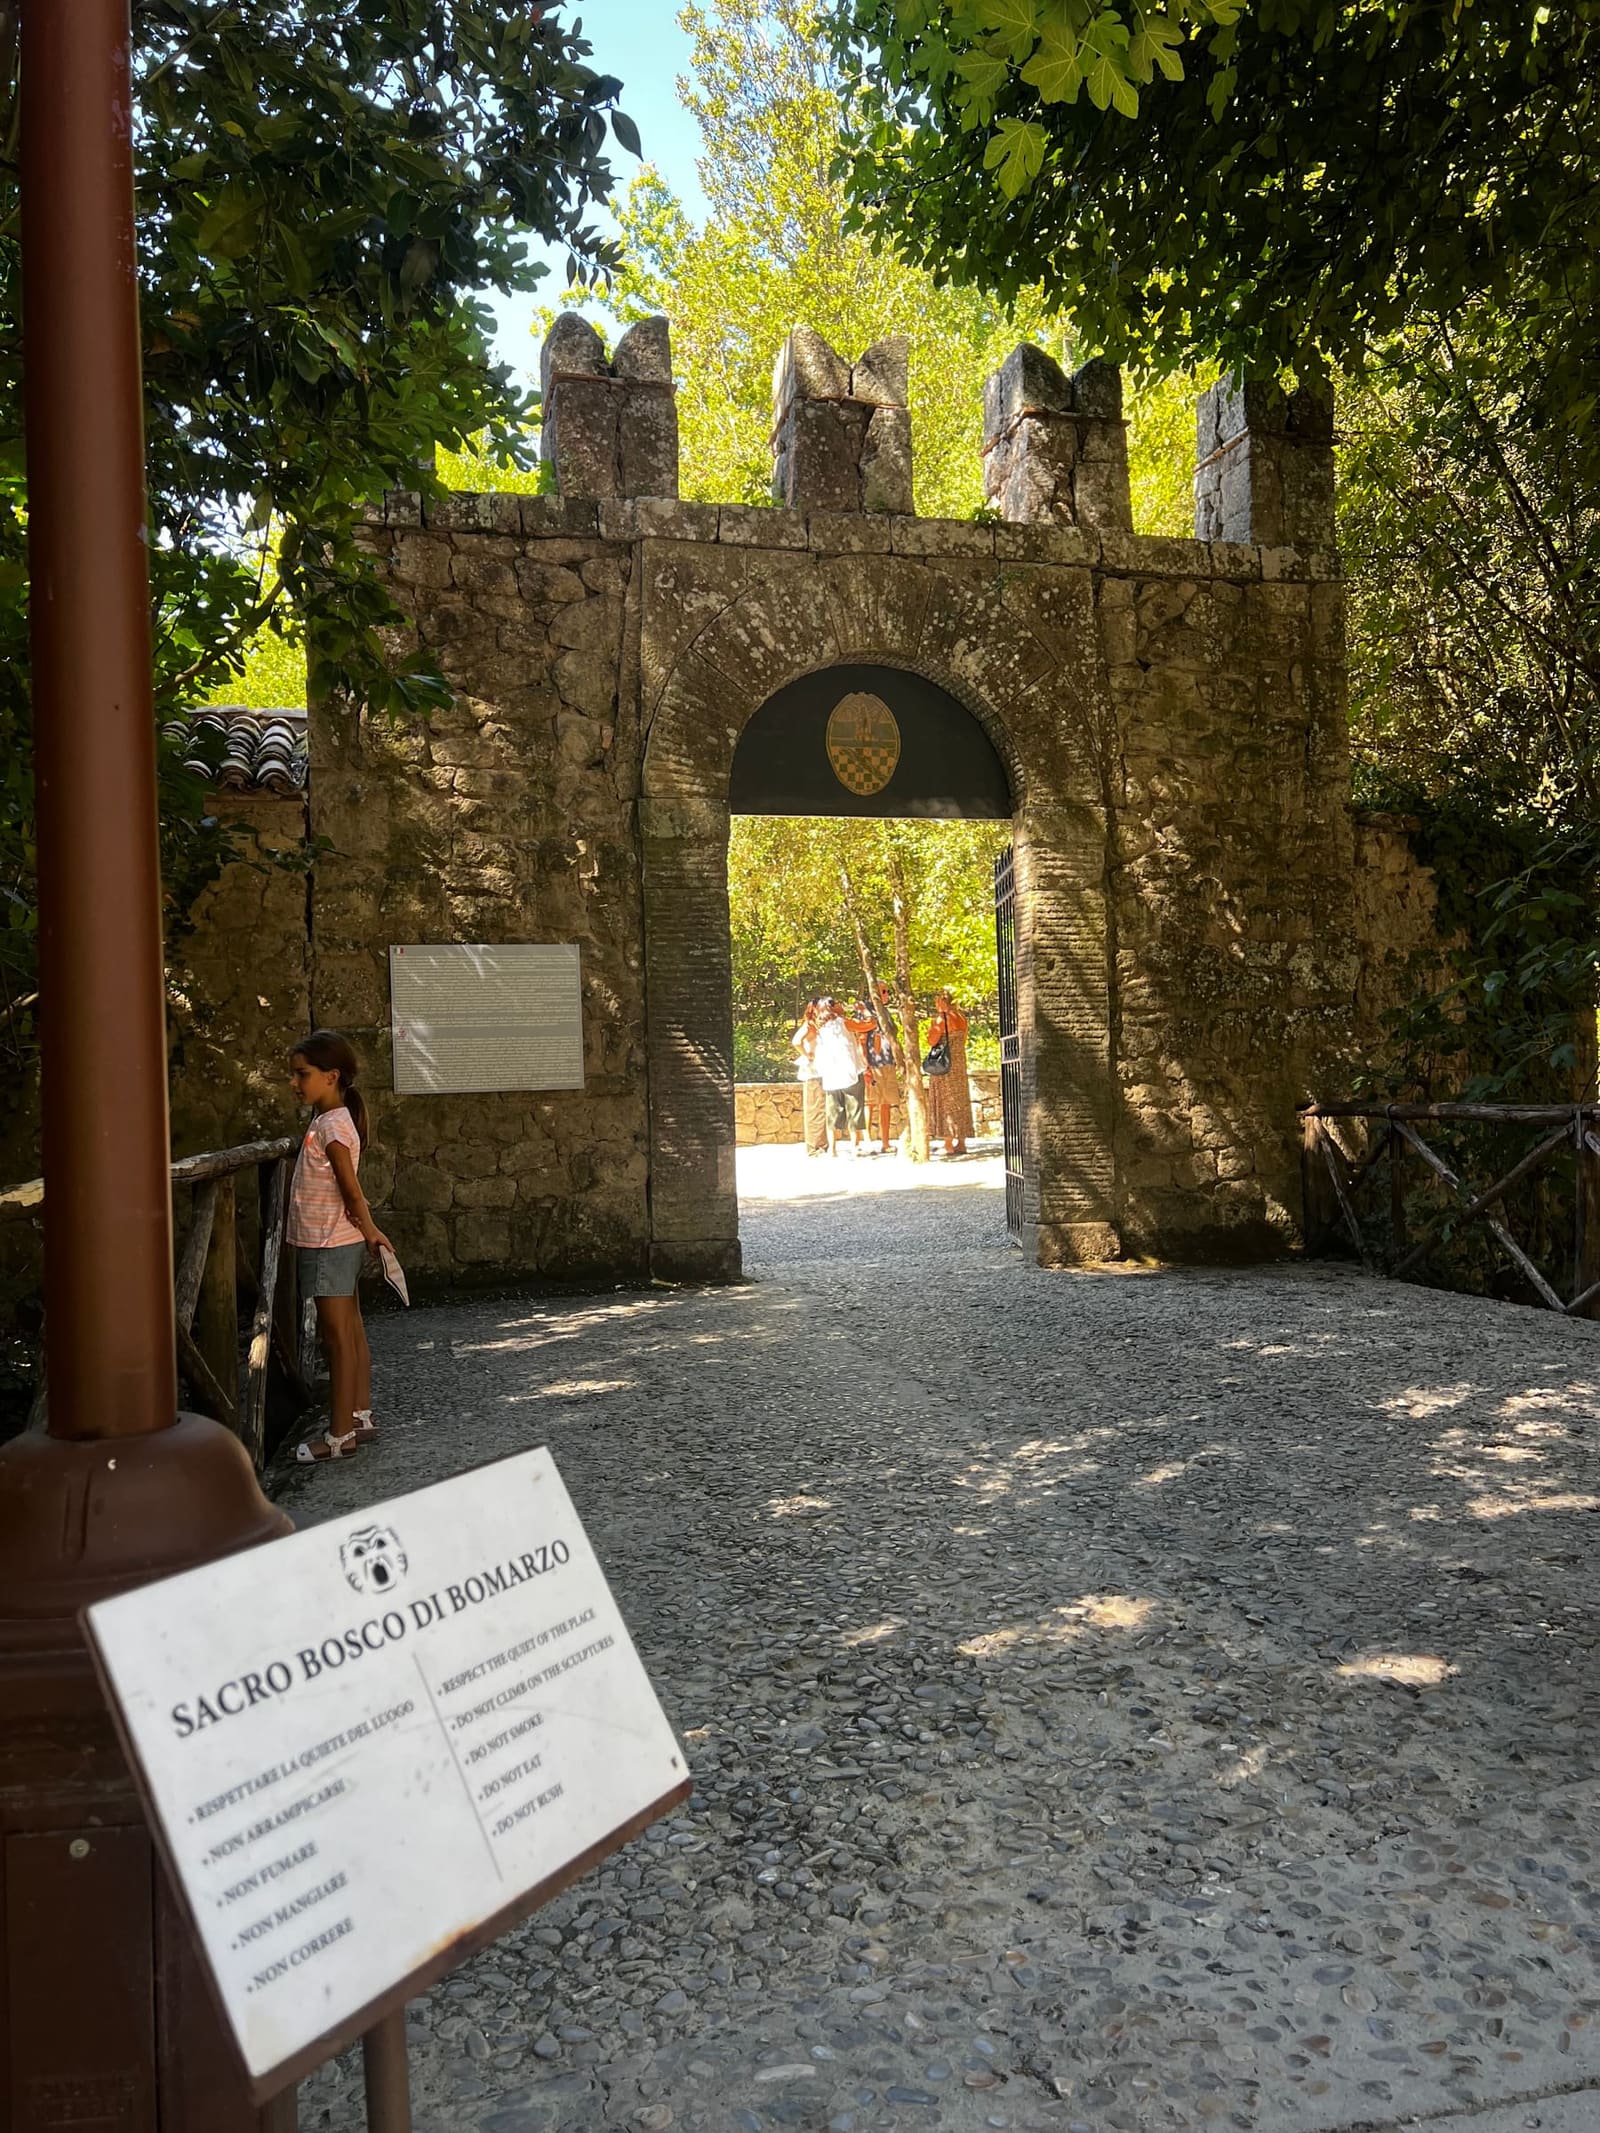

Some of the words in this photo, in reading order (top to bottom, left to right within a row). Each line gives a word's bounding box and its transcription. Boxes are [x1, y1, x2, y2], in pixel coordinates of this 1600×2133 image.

[171, 1661, 292, 1738] SACRO
[297, 1612, 406, 1681] BOSCO
[409, 1594, 446, 1631] DI
[445, 1539, 570, 1614] BOMARZO
[442, 1664, 486, 1695] RESPECT
[486, 1653, 508, 1673] THE
[507, 1638, 537, 1662] QUIET
[537, 1632, 550, 1647] OF
[549, 1622, 570, 1640] THE
[568, 1608, 596, 1631] PLACE
[456, 1712, 473, 1728] DO
[472, 1700, 496, 1719] NOT
[496, 1682, 528, 1706] CLIMB
[527, 1673, 543, 1690] ON
[542, 1664, 562, 1682] THE
[561, 1635, 615, 1670] SCULPTURES
[195, 1768, 282, 1821] RISPETTARE
[280, 1758, 299, 1778] LA
[299, 1733, 348, 1767] QUIETE
[346, 1721, 373, 1743] DEL
[371, 1700, 415, 1731] LUOGO
[469, 1744, 487, 1763] DO
[486, 1731, 509, 1753] NOT
[509, 1712, 544, 1740] SMOKE
[483, 1780, 500, 1798] DO
[500, 1765, 523, 1787] NOT
[522, 1752, 542, 1774] EAT
[209, 1834, 245, 1863] NON
[247, 1778, 346, 1843] ARRAMPICARSI
[496, 1815, 514, 1834] DO
[513, 1799, 536, 1822] NOT
[536, 1781, 564, 1808] RUSH
[223, 1873, 259, 1905] NON
[260, 1840, 319, 1884] FUMARE
[238, 1915, 274, 1948] NON
[274, 1872, 349, 1926] MANGIARE
[253, 1957, 289, 1990] NON
[290, 1917, 355, 1966] CORRERE
